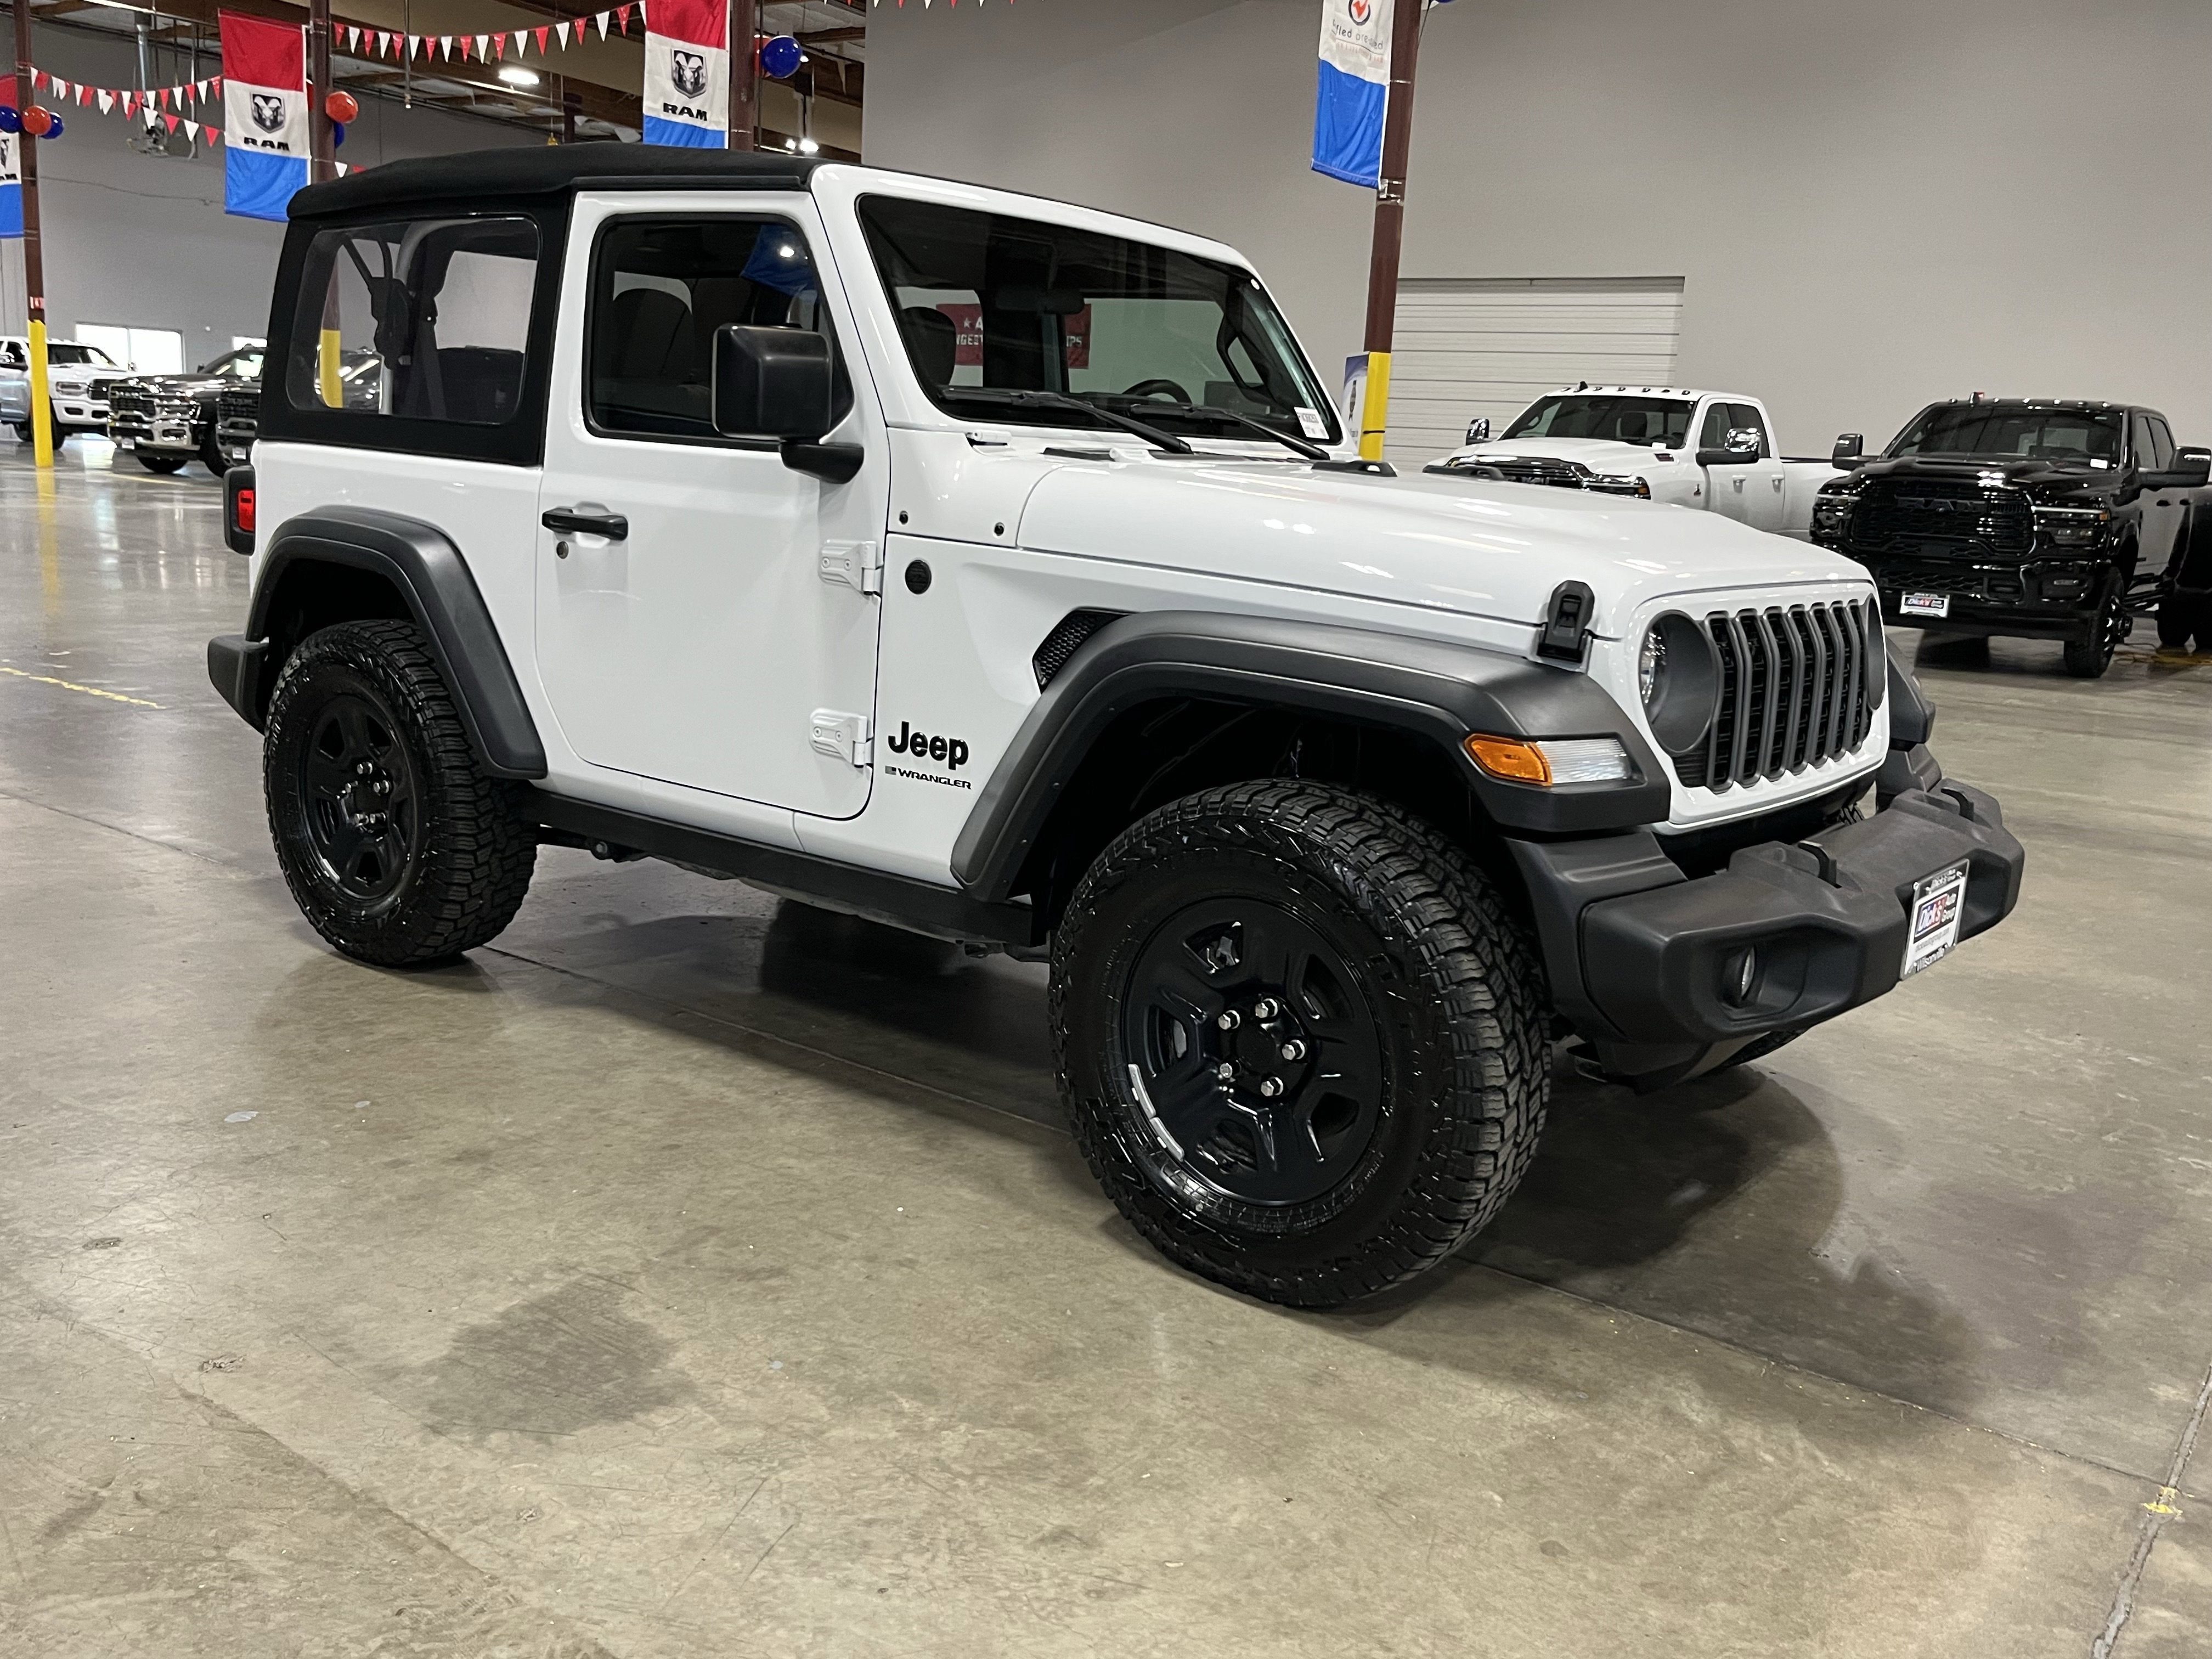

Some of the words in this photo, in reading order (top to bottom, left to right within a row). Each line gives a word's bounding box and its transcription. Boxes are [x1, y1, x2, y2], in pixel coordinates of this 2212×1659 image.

[663, 102, 708, 121] RAM
[244, 136, 290, 151] RAM
[888, 721, 969, 771] Jeep
[898, 767, 972, 790] WRANGLER
